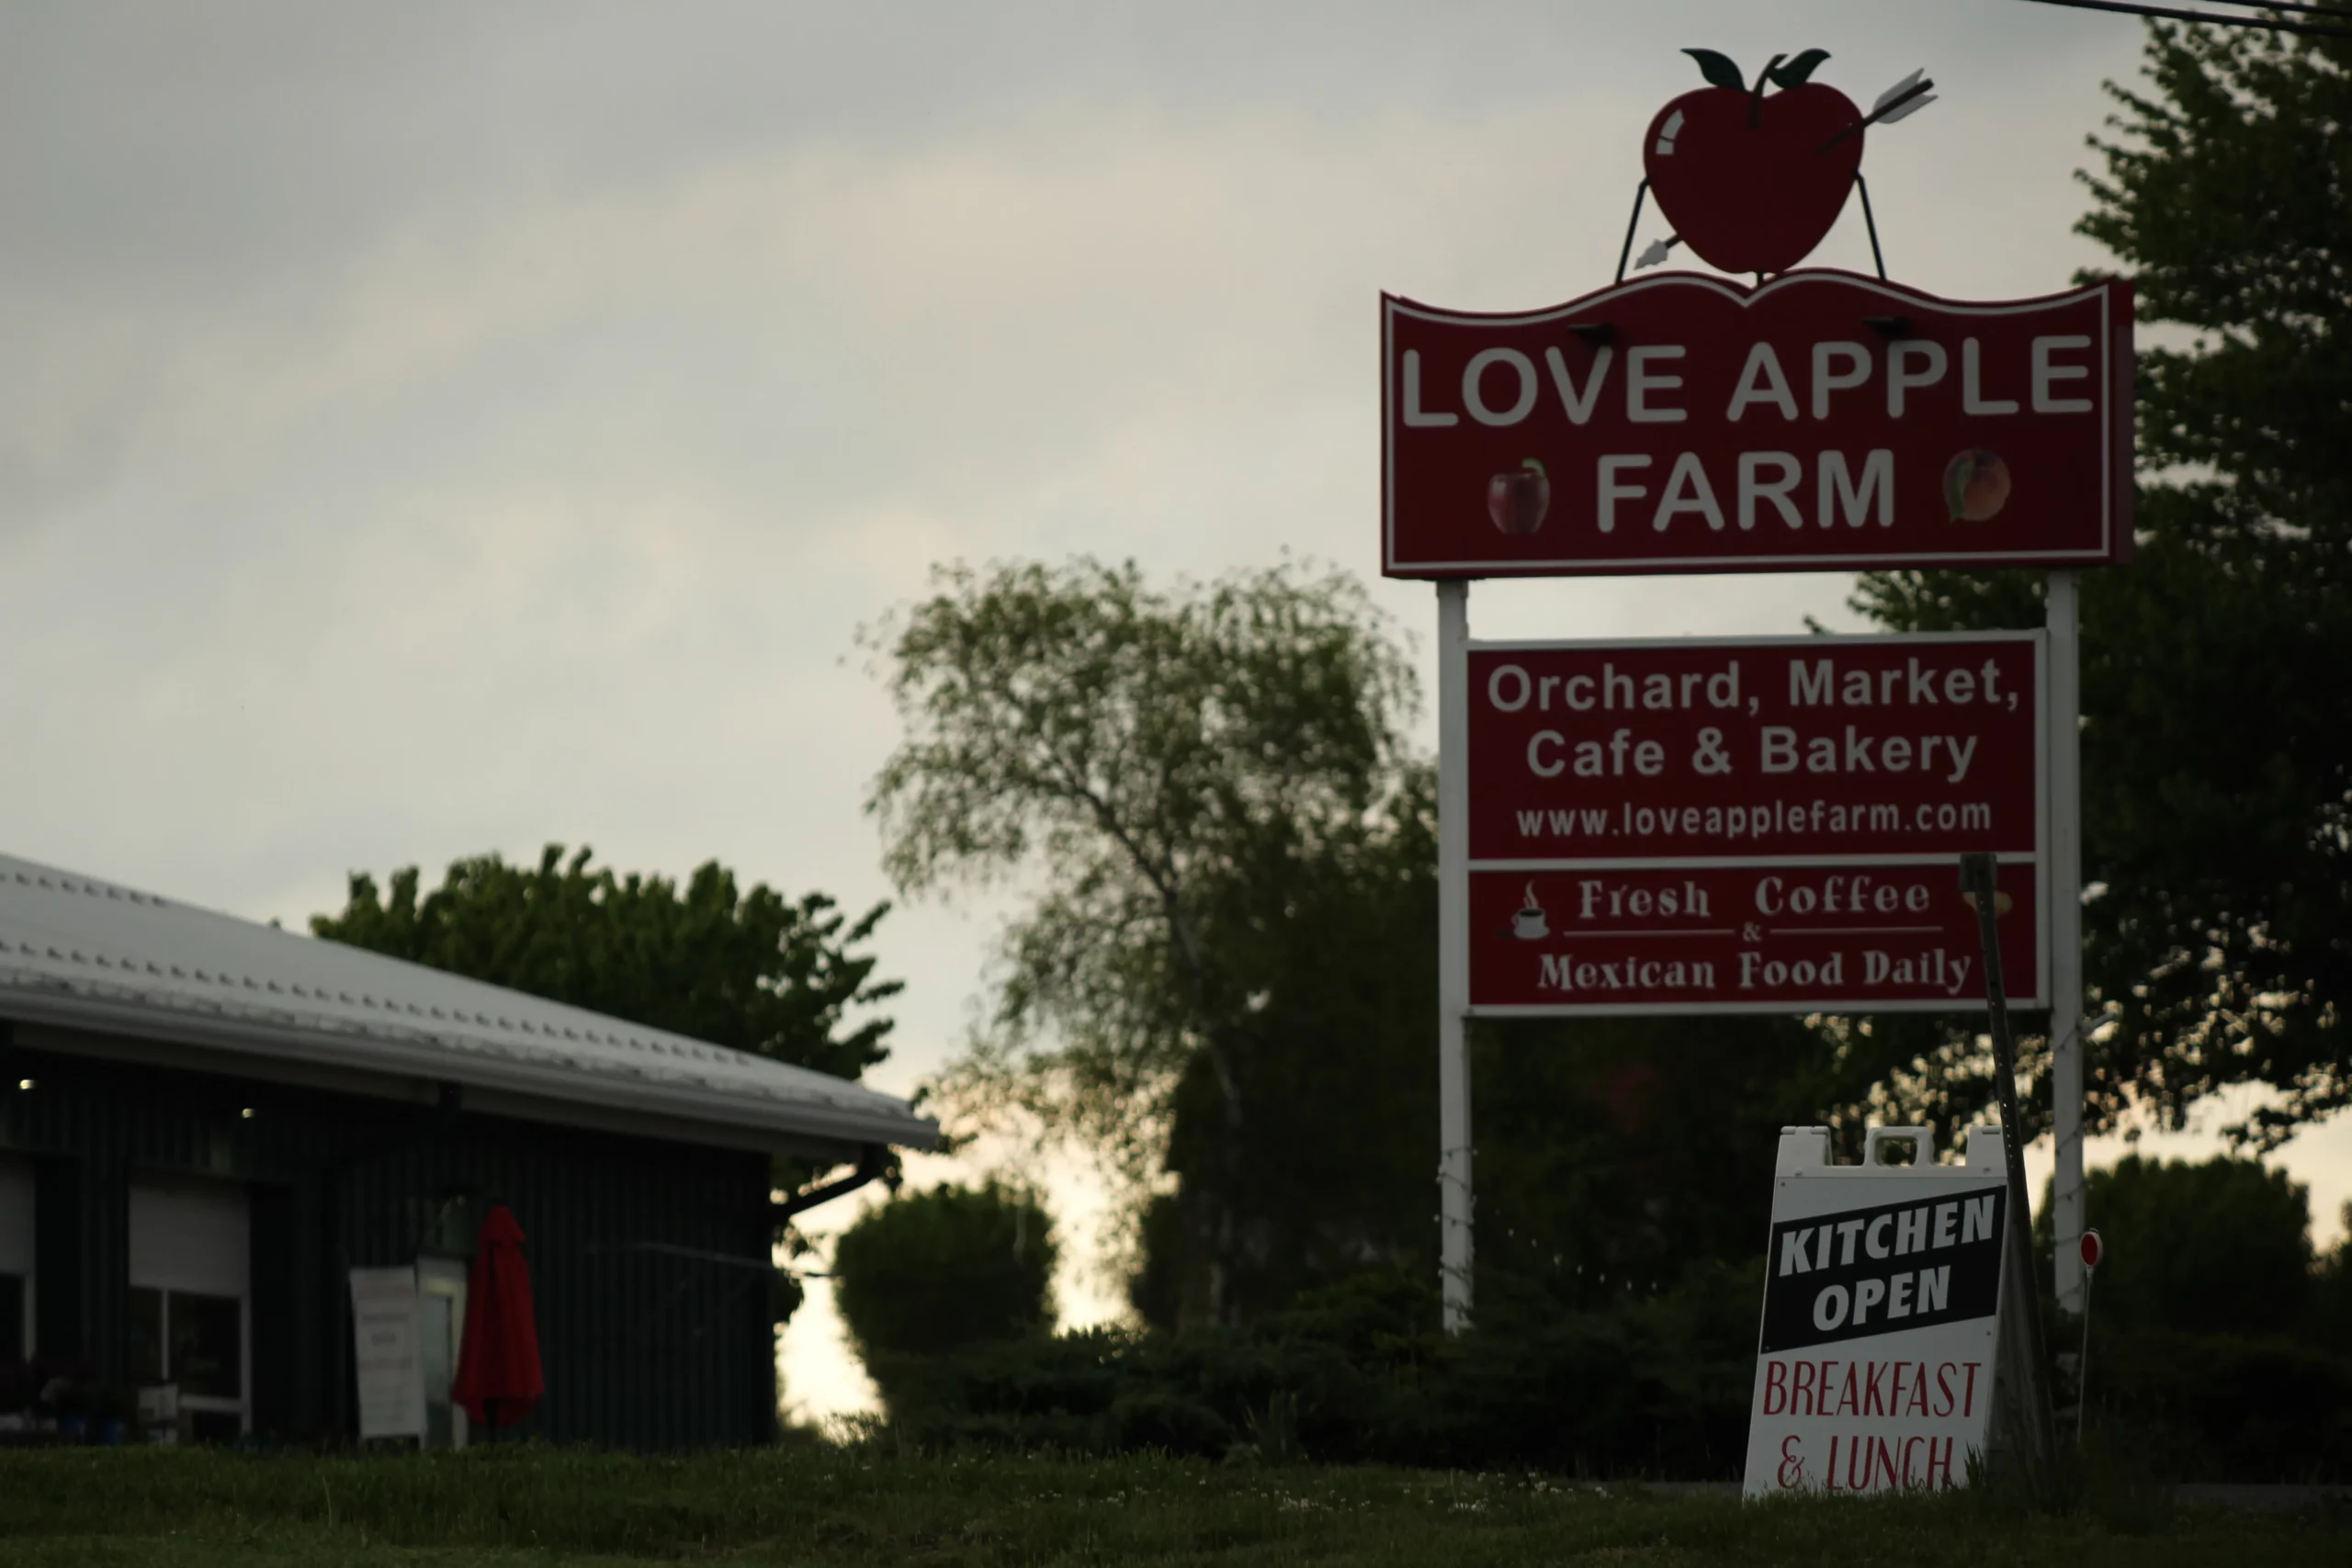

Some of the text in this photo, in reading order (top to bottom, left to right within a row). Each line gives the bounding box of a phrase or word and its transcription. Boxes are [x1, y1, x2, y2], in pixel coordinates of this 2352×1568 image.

[1402, 334, 2094, 427] LOVE APPLE
[1596, 448, 1895, 533] FARM
[1487, 657, 2019, 716] Orchard, Market,
[1526, 724, 1979, 784] Cafe & Bakery
[1516, 798, 1992, 840] www.loveapplefarm.com
[1577, 875, 1930, 919] Fresh Coffee
[1742, 921, 1762, 942] &
[1537, 948, 1972, 995] Mexican Food Daily
[1779, 1194, 1996, 1277] KITCHEN
[1812, 1264, 1951, 1332] OPEN
[1763, 1360, 1981, 1417] BREAKFAST
[1777, 1435, 1953, 1491] & LUNCH
